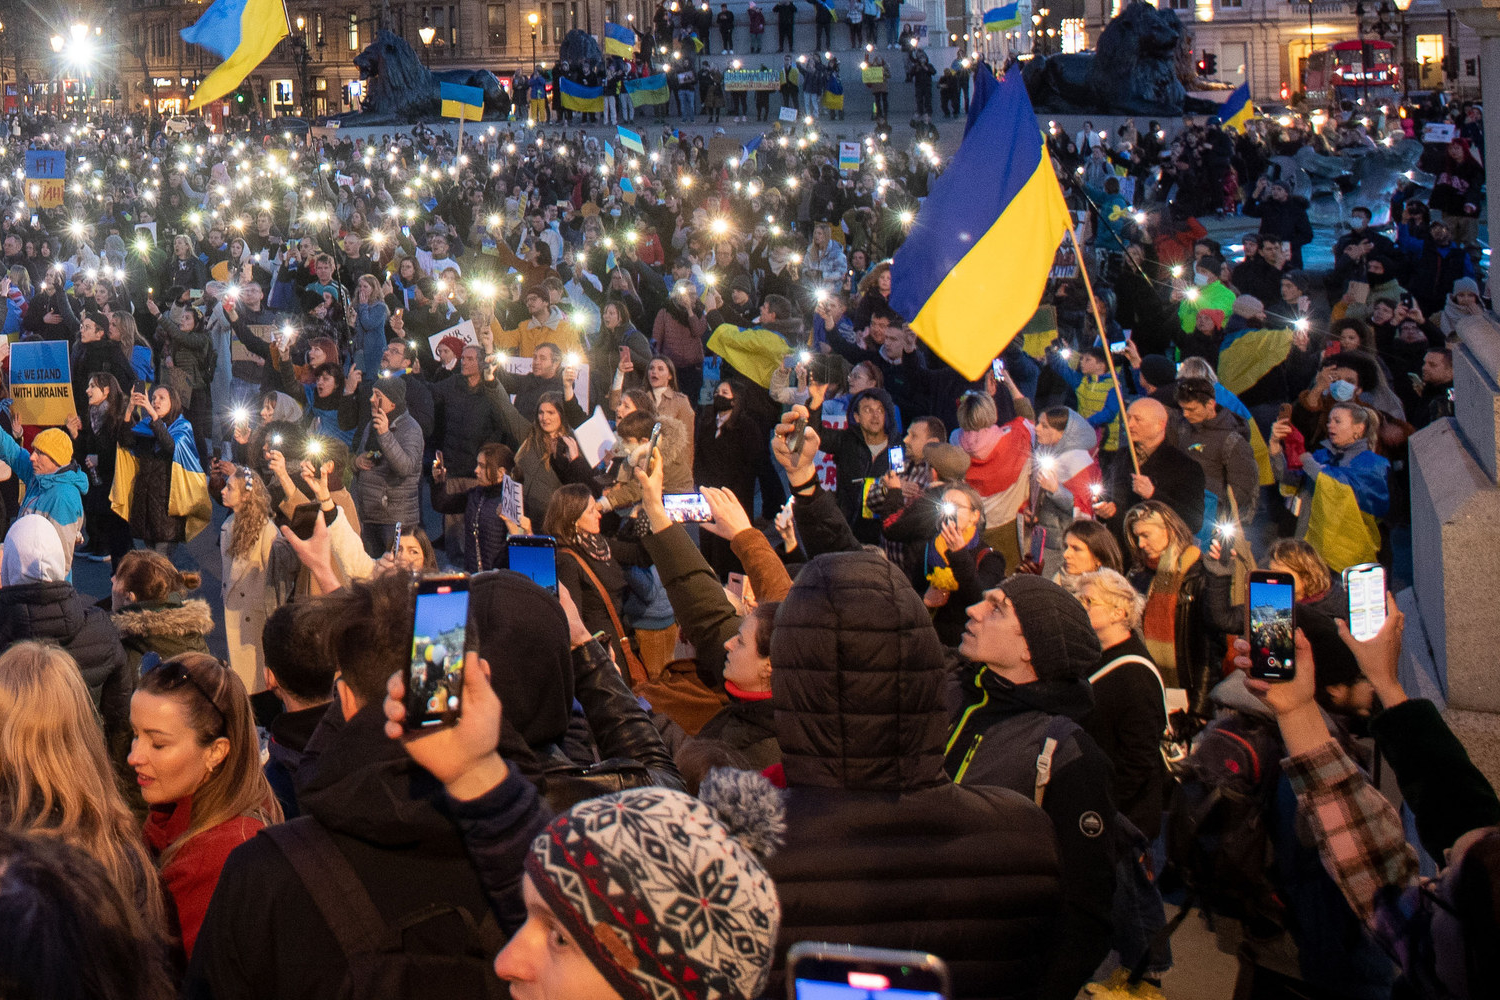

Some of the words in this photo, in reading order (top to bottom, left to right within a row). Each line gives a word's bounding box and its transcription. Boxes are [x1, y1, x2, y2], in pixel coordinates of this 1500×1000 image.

[23, 369, 35, 380] WE
[36, 368, 61, 380] STAND
[12, 386, 33, 399] WITH
[33, 386, 69, 398] UKRAINE
